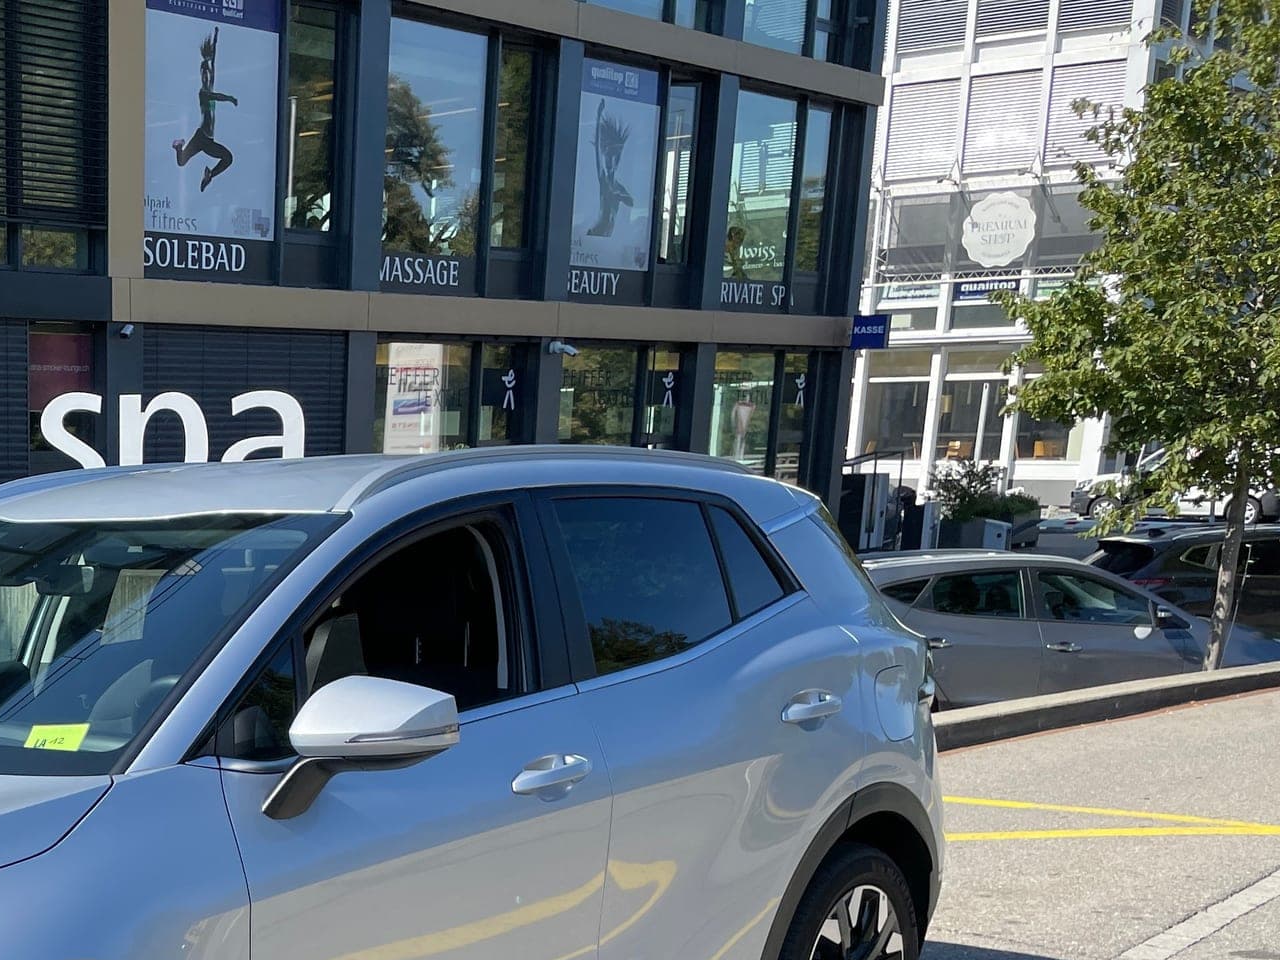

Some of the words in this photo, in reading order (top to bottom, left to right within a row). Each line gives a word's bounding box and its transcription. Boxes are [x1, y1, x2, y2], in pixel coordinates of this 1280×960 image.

[152, 210, 198, 231] fitness
[970, 219, 1028, 233] PREMIUM
[981, 233, 1015, 245] SHOP
[143, 237, 246, 272] SOLEBAD
[567, 270, 620, 296] EAUTY
[720, 282, 764, 305] RIVATE
[853, 325, 885, 335] KASSE
